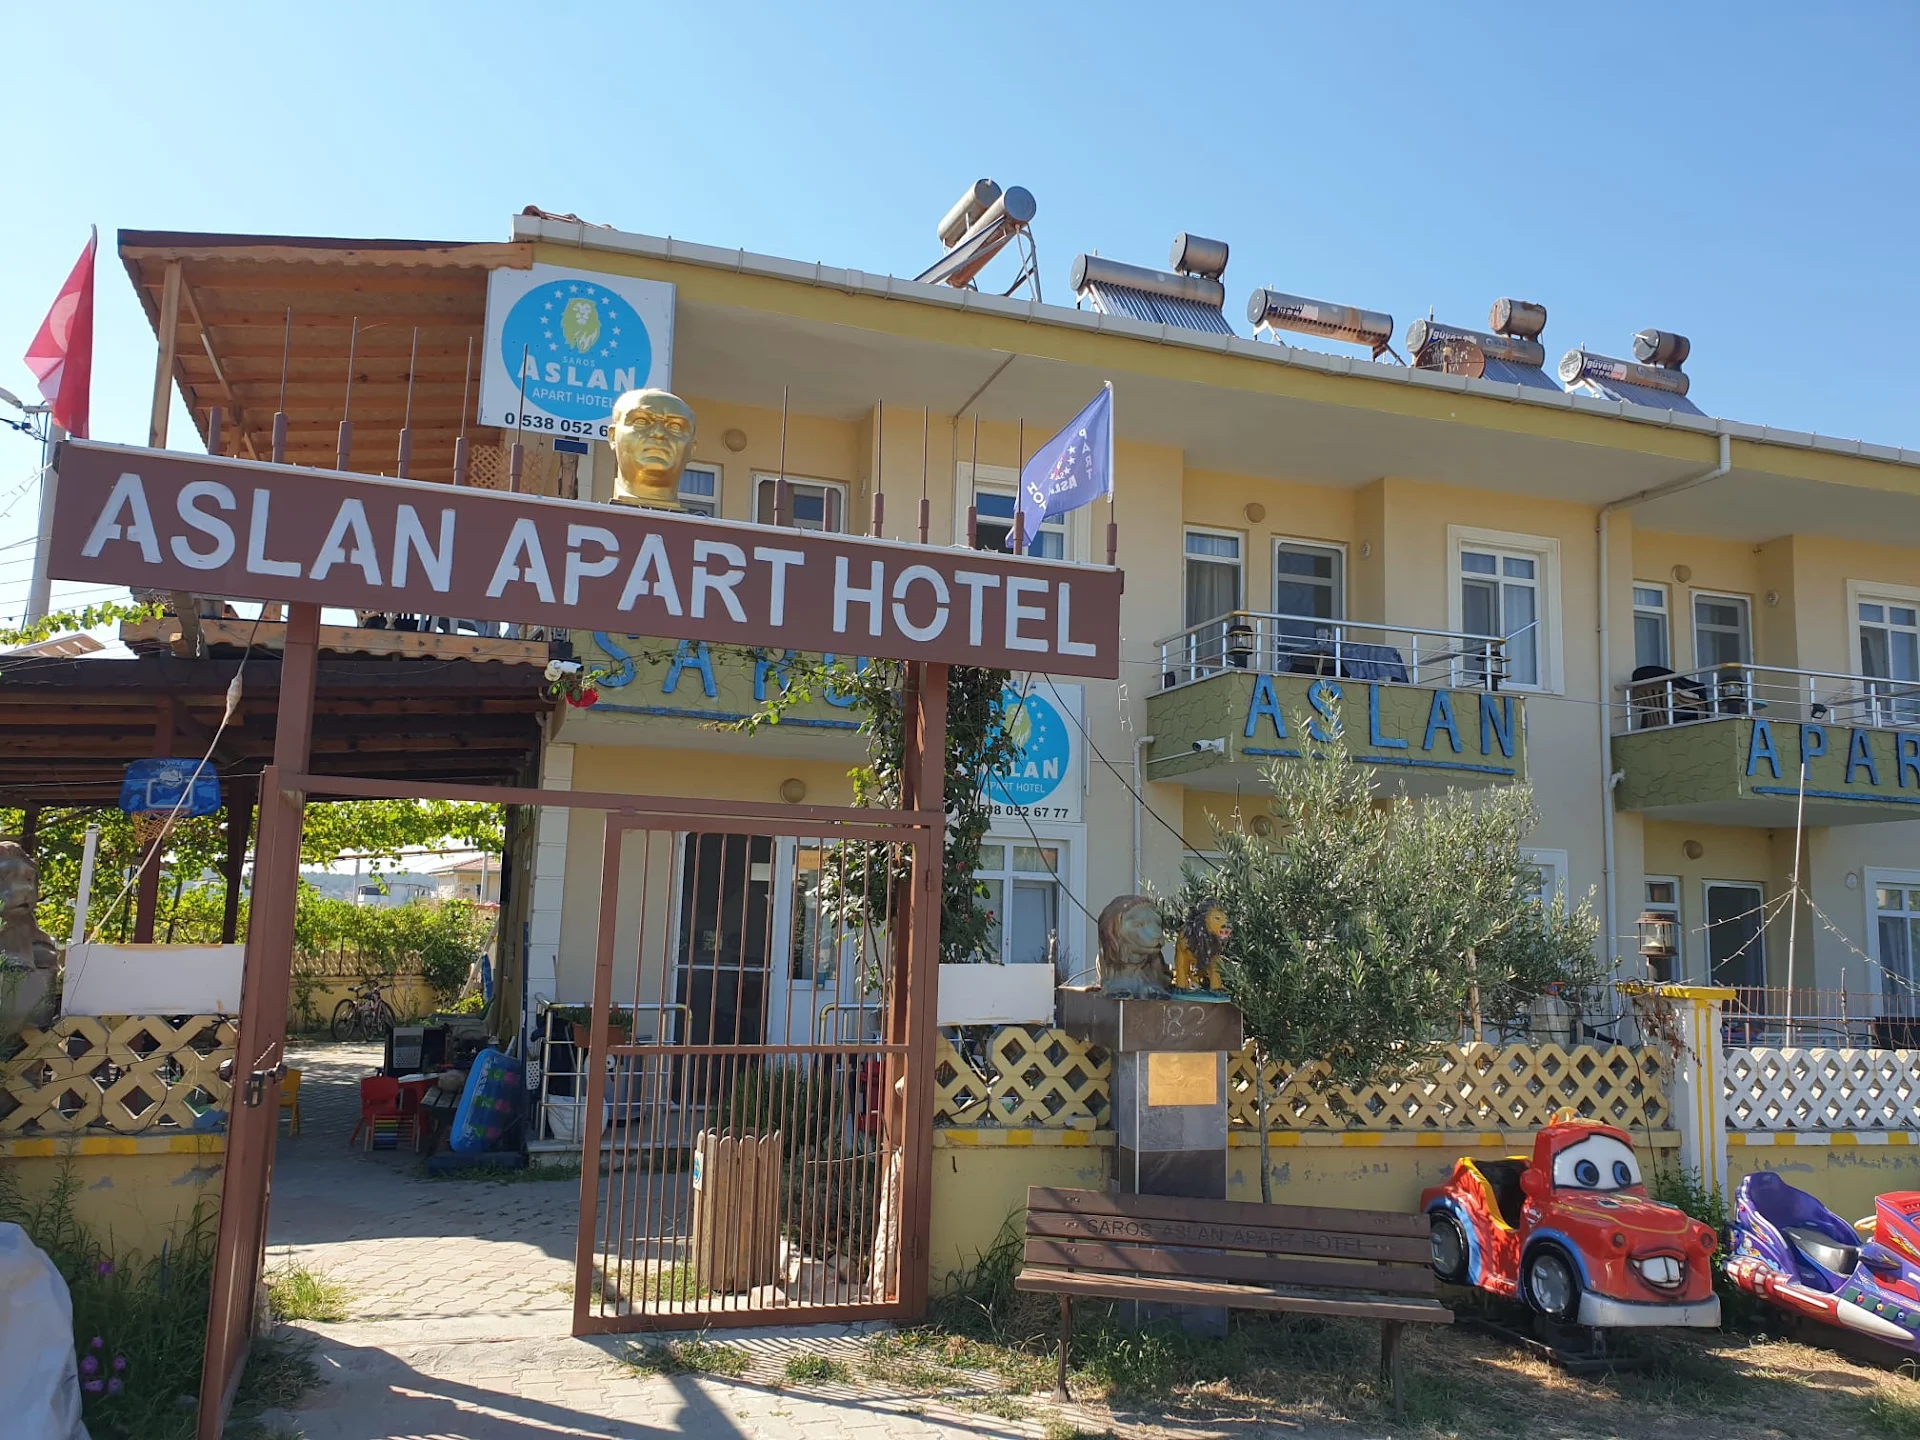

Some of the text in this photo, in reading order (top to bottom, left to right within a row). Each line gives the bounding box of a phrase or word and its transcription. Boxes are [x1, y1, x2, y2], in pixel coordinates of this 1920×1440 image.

[518, 354, 636, 392] ASLAN
[563, 356, 595, 367] SAROS
[532, 387, 614, 408] APART HOTEL
[505, 412, 515, 425] 0
[522, 414, 554, 430] 538
[561, 419, 593, 435] 052
[81, 472, 1097, 658] ASLAN APART HOTEL
[1244, 673, 1515, 758] ASLAN
[1746, 719, 1920, 788] APAR
[1016, 782, 1046, 793] HOTEL
[1006, 805, 1030, 817] 052
[1034, 807, 1049, 817] 67
[1053, 808, 1069, 819] 77
[1087, 1219, 1364, 1252] SAROS ASLAN APART HOTEL
